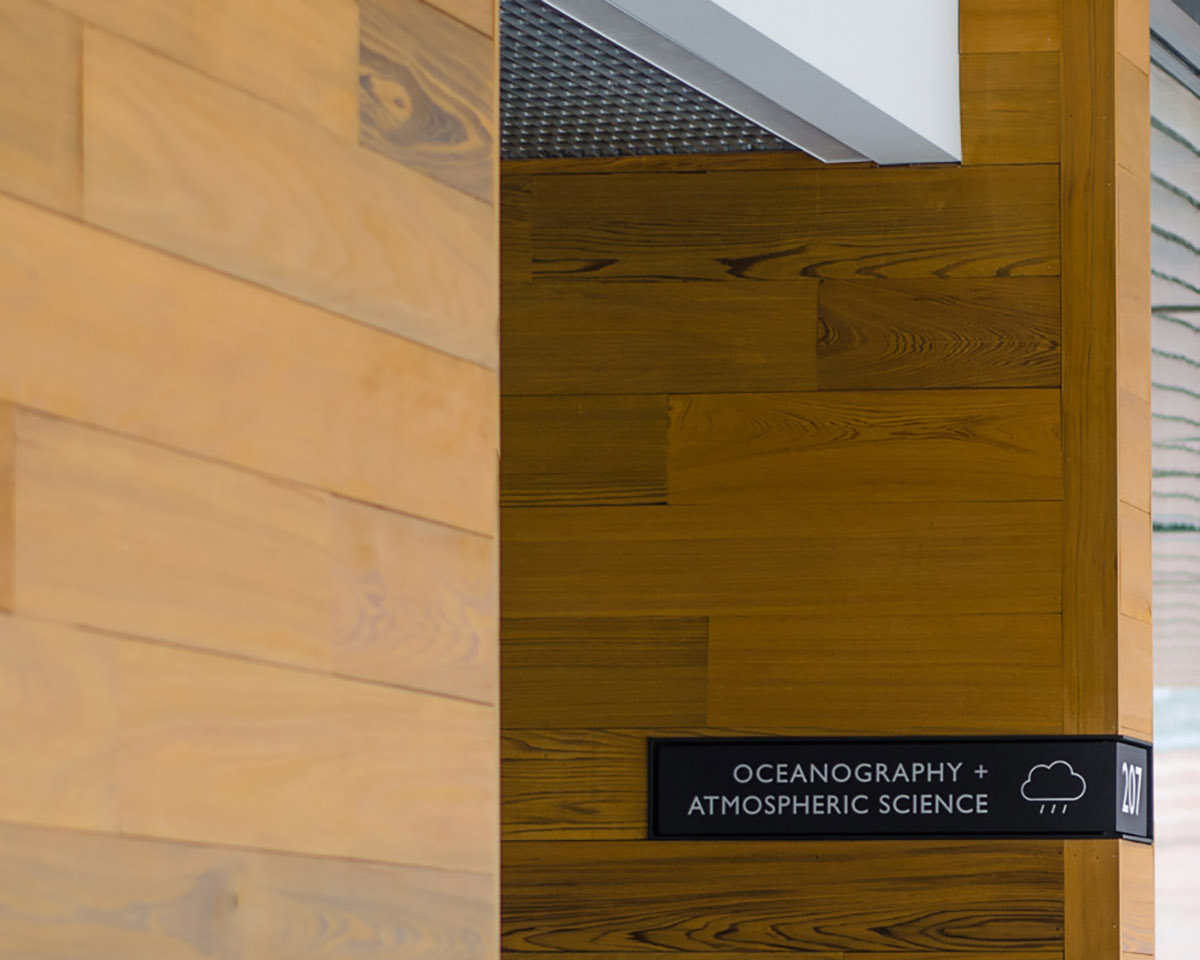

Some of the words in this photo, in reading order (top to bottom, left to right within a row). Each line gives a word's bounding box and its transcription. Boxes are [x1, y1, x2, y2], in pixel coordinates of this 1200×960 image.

[733, 762, 963, 784] OCEANOGRAPHY
[975, 764, 989, 779] +
[1122, 762, 1142, 816] 207
[688, 794, 869, 816] ATMOSPHERIC
[878, 793, 989, 815] SCIENCE
